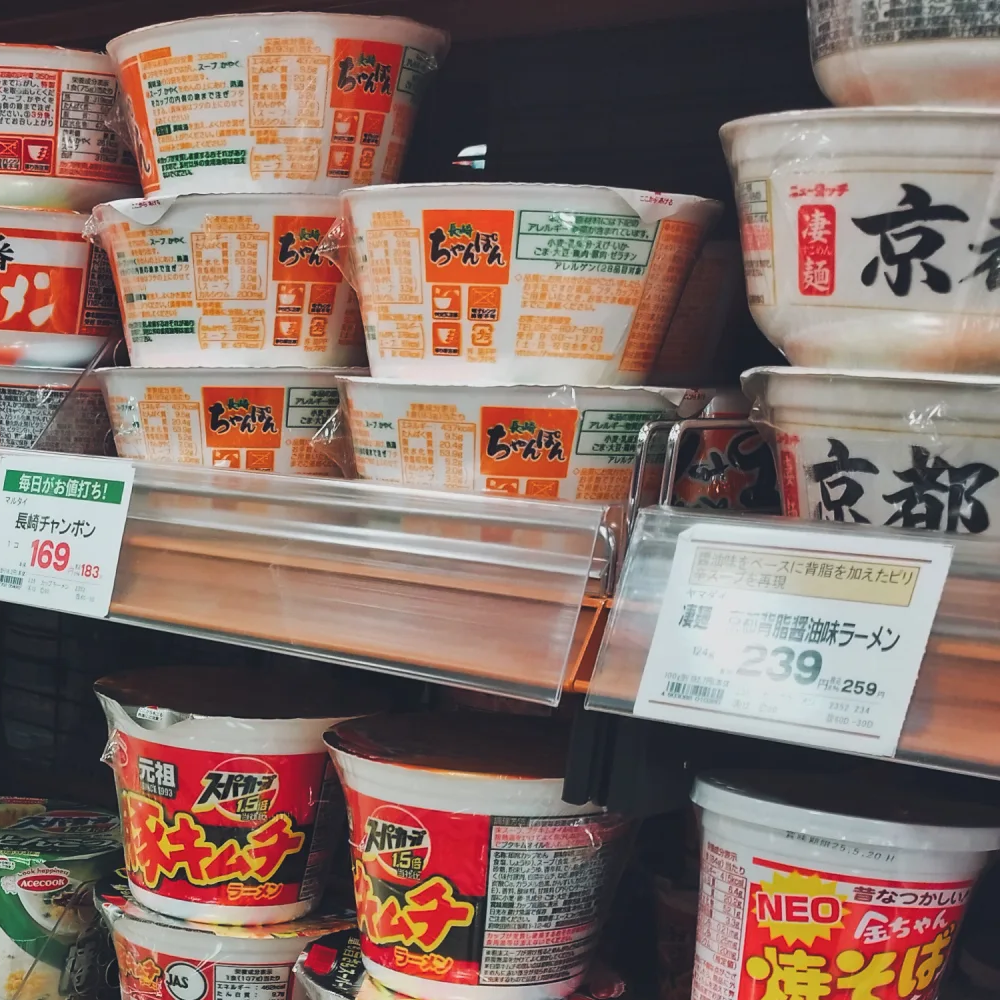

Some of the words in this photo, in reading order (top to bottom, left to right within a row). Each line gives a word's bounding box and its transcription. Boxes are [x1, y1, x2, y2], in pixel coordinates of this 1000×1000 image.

[337, 58, 393, 96] ちゃんぽん
[447, 221, 473, 238] 長崎
[428, 226, 506, 267] ちゃんぽん
[801, 207, 832, 293] 凄麺
[208, 402, 278, 434] ちゃんぽん
[509, 420, 536, 433] 長崎
[486, 424, 566, 462] ちゃんぽん
[5, 496, 28, 505] マルタイ
[19, 474, 108, 500] 毎日がお値打ち!
[15, 512, 96, 538] 長崎チャンポン
[30, 539, 71, 571] 169
[81, 563, 100, 579] 183
[736, 645, 823, 686] 239
[841, 679, 877, 697] 259
[138, 757, 177, 788] 元祖
[236, 796, 269, 813] 1.5倍
[364, 818, 429, 852] スーパーカップ
[391, 852, 422, 871] 1.5倍
[227, 883, 284, 900] ラーメン
[853, 886, 970, 905] 昔なつかしい!
[756, 892, 842, 924] NEO
[854, 909, 949, 945] 金ちゃん
[394, 946, 454, 975] ラーメン
[165, 973, 189, 989] JAS
